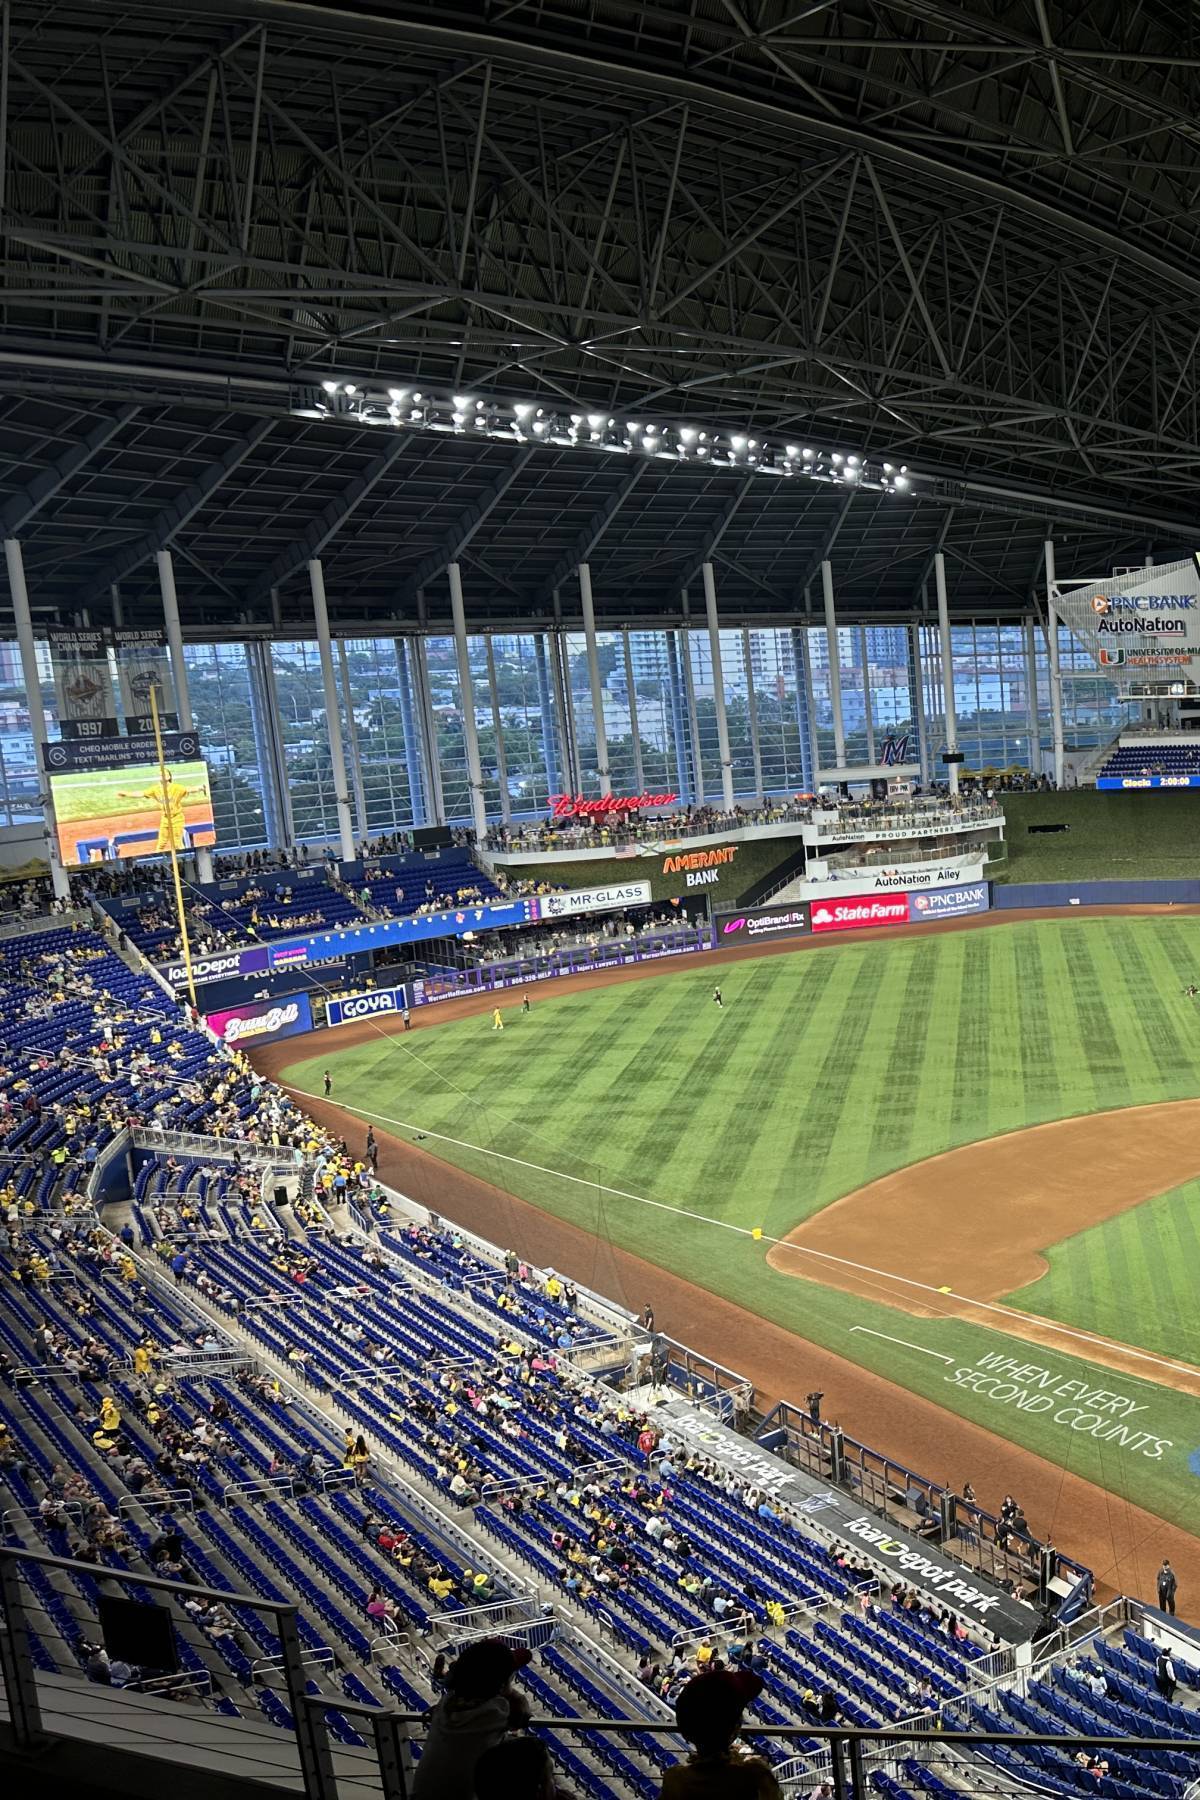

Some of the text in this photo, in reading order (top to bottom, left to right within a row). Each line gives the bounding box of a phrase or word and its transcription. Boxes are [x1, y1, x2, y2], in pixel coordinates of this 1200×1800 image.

[1111, 594, 1197, 610] PNC BANK
[1098, 618, 1184, 633] AutoNation
[51, 632, 102, 642] WORLD SERIES
[114, 630, 162, 641] WORLD SERIES
[1127, 647, 1171, 657] UNIVERSITY
[77, 722, 102, 736] 1997
[138, 717, 167, 732] 203
[80, 745, 101, 753] CHEQ
[102, 742, 130, 752] MOBILE
[73, 751, 145, 764] TEXT "MARLINS" TO
[547, 793, 677, 817] Budweiser
[832, 833, 865, 841] AutoNation
[875, 831, 907, 839] PROUD
[912, 826, 954, 837] PARTNERS
[663, 847, 736, 873] AMERANT
[686, 869, 719, 887] BANK
[875, 874, 931, 888] AutoNation
[938, 870, 961, 881] Alley
[930, 888, 985, 907] PNC BANK
[577, 959, 618, 973] Injury Lawyers
[343, 993, 393, 1017] GOYA
[976, 1352, 1150, 1418] WHEN EVERY
[944, 1368, 1173, 1461] SECOND COUNTS.
[673, 1414, 797, 1488] loanDepot park
[843, 1517, 1001, 1614] loanDepot park
